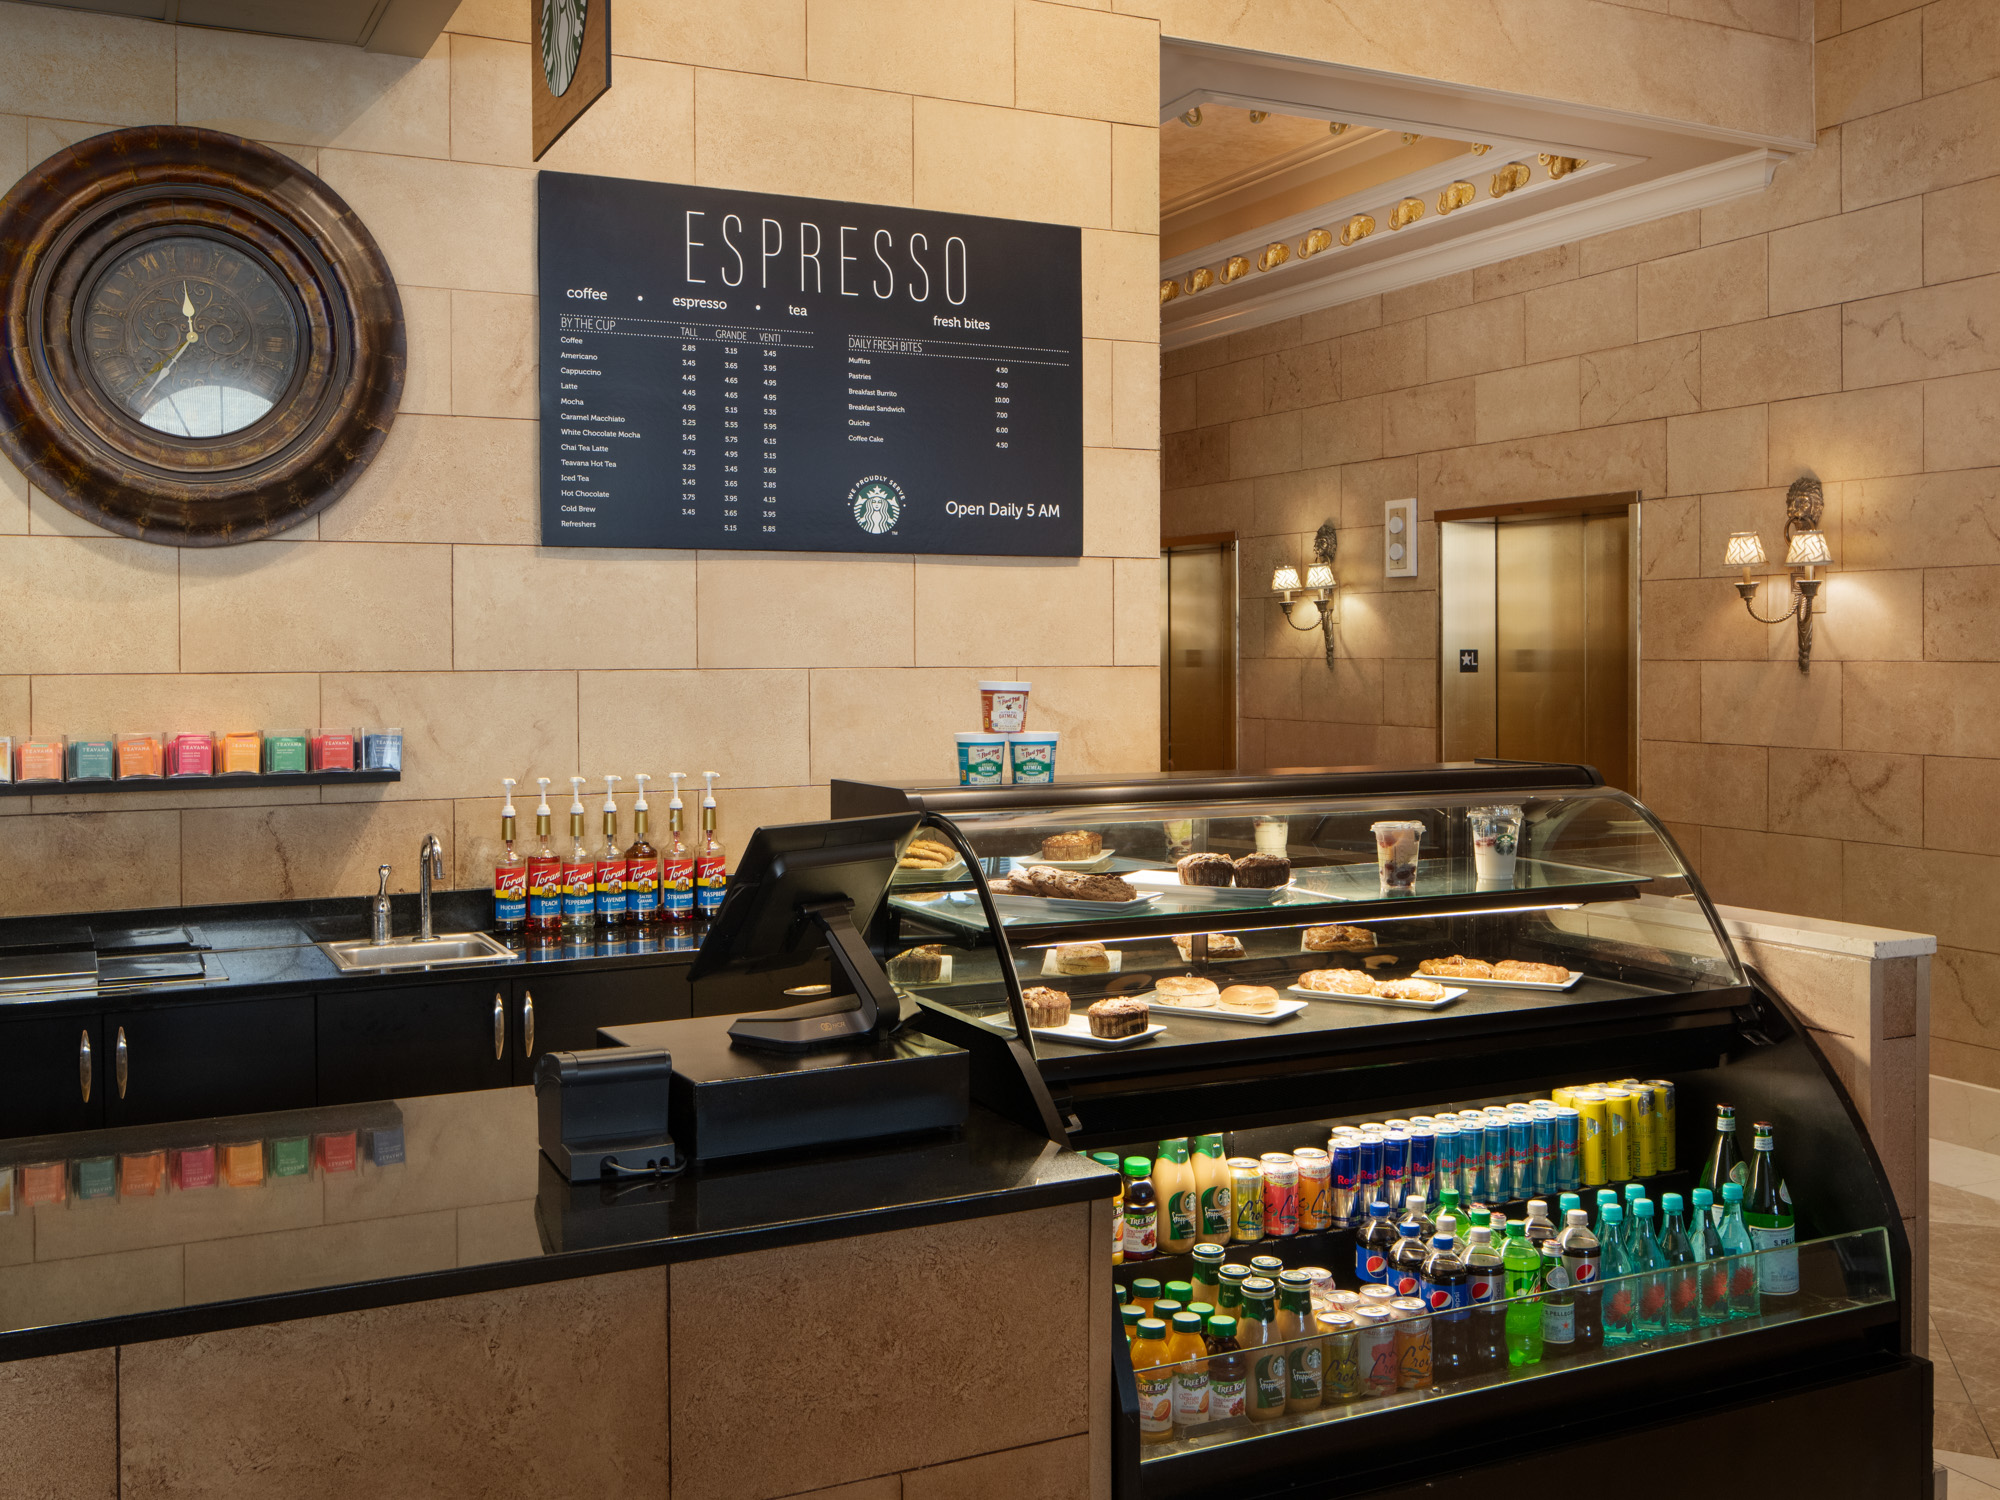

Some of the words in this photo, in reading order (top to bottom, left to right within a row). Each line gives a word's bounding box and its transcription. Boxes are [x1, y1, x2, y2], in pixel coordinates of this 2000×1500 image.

[686, 210, 968, 306] ESPRESSO
[566, 287, 608, 301] coffee
[672, 296, 728, 310] espresso
[788, 304, 808, 317] tea
[561, 316, 573, 328] BY
[573, 318, 594, 330] THE
[595, 319, 617, 331] CUP
[933, 315, 961, 328] fresh
[964, 318, 991, 331] bites
[680, 326, 699, 337] TALL
[715, 329, 748, 341] GRANDE
[561, 336, 584, 345] Coffee
[759, 332, 781, 343] VENTI
[682, 344, 697, 352] 2.85
[848, 337, 872, 349] DAILY
[873, 339, 899, 351] FRESH
[900, 341, 923, 353] BITES
[724, 347, 738, 355] 3.15
[763, 349, 777, 357] 3.45
[561, 351, 599, 361] Americano
[682, 359, 697, 367] 3.45
[848, 356, 871, 365] Muffins
[724, 362, 738, 370] 3.65
[763, 364, 777, 372] 3.95
[996, 366, 1009, 374] 4.50
[561, 366, 602, 376] Cappuccino
[682, 374, 697, 382] 4.45
[724, 376, 738, 384] 4.65
[848, 372, 872, 381] Pastries
[561, 382, 579, 390] Latte
[763, 379, 777, 387] 4.95
[996, 381, 1009, 389] 4.50
[682, 389, 697, 397] 4.45
[724, 391, 738, 399] 4.65
[848, 387, 876, 396] Breakfast
[876, 389, 898, 398] Burrito
[763, 393, 777, 401] 4.95
[994, 396, 1010, 404] 10.00
[561, 397, 585, 406] Mocha
[682, 404, 697, 412] 4.95
[724, 406, 738, 414] 5.15
[763, 408, 777, 416] 5.35
[848, 403, 876, 412] Breakfast
[876, 405, 906, 413] Sandwich
[561, 412, 590, 421] Caramel
[590, 414, 626, 423] Macchiato
[996, 411, 1009, 419] 7.00
[682, 419, 697, 427] 5.25
[724, 420, 738, 428] 5.55
[848, 418, 871, 427] Quiche
[763, 423, 777, 431] 5.95
[996, 426, 1009, 434] 6.00
[561, 428, 581, 437] White
[582, 429, 617, 438] Chocolate
[618, 430, 641, 439] Mocha
[682, 433, 697, 441] 5.45
[724, 435, 738, 443] 5.75
[763, 437, 777, 445] 6.15
[848, 434, 868, 442] Coffee
[869, 435, 885, 443] Cake
[561, 443, 577, 451] Chai
[578, 444, 591, 452] Tea
[591, 445, 609, 453] Latte
[996, 441, 1009, 449] 4.50
[682, 448, 697, 456] 4.75
[724, 450, 738, 458] 4.95
[763, 452, 777, 460] 5.15
[561, 458, 589, 467] Teavana
[590, 460, 604, 468] Hot
[604, 460, 617, 468] Tea
[682, 463, 697, 471] 3.25
[724, 465, 738, 473] 3.45
[763, 466, 777, 474] 3.65
[561, 474, 576, 482] Iced
[577, 474, 590, 482] Tea
[682, 478, 697, 486] 3.45
[724, 480, 738, 488] 3.65
[763, 481, 777, 489] 3.85
[847, 487, 857, 500] WE
[855, 474, 888, 489] PROUDLY
[888, 479, 906, 501] SERVE
[561, 489, 574, 497] Hot
[574, 490, 610, 498] Chocolate
[682, 493, 697, 501] 3.75
[724, 494, 738, 502] 3.95
[763, 496, 777, 504] 4.15
[561, 504, 578, 512] Cold
[578, 505, 597, 513] Brew
[682, 508, 697, 516] 3.45
[945, 500, 985, 518] Open
[989, 502, 1023, 520] Daily
[1026, 503, 1035, 517] 5
[1038, 504, 1060, 518] AM
[724, 509, 738, 517] 3.65
[763, 510, 777, 518] 3.95
[561, 519, 597, 528] Refreshers
[724, 524, 738, 532] 5.15
[763, 525, 777, 533] 5.85
[564, 867, 594, 887] Torani
[565, 898, 594, 906] PEPPERMINT
[1183, 1378, 1199, 1387] TREE
[1138, 1382, 1154, 1392] TREE
[1217, 1384, 1233, 1394] TREE
